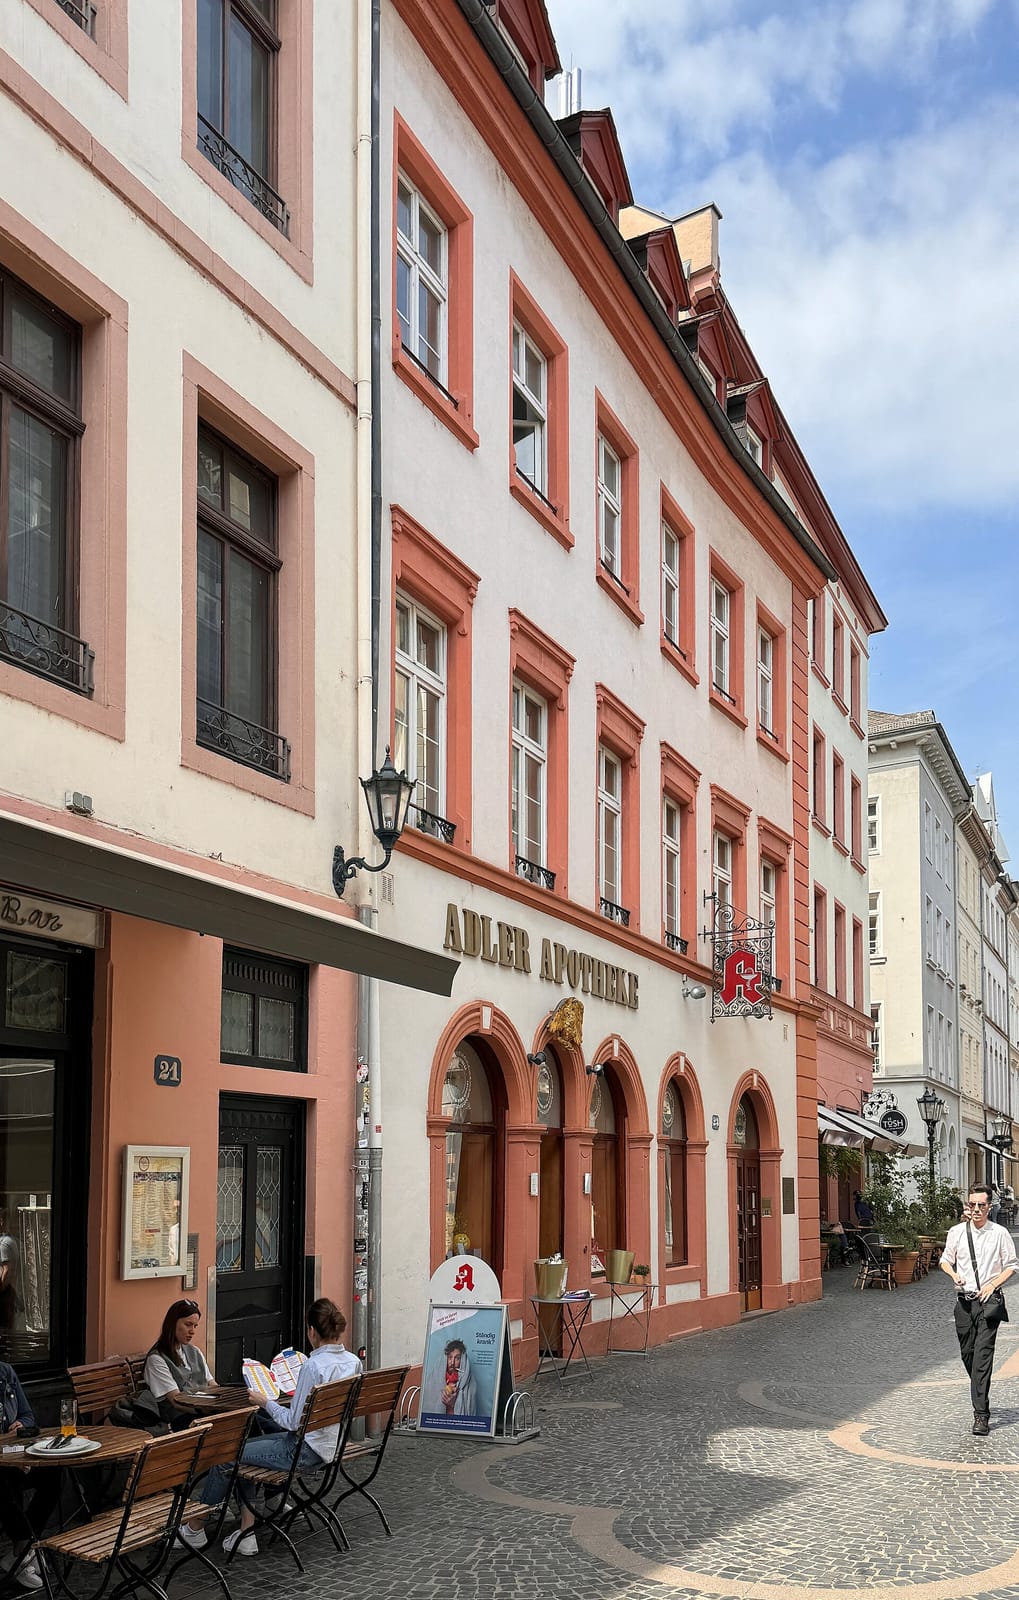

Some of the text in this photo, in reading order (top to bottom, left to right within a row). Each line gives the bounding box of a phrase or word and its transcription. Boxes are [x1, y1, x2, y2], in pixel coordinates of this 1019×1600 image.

[1, 896, 63, 931] Bar
[443, 903, 639, 1009] ADLER APOTHEKE
[159, 1061, 180, 1082] 21
[475, 1332, 496, 1340] Ständig
